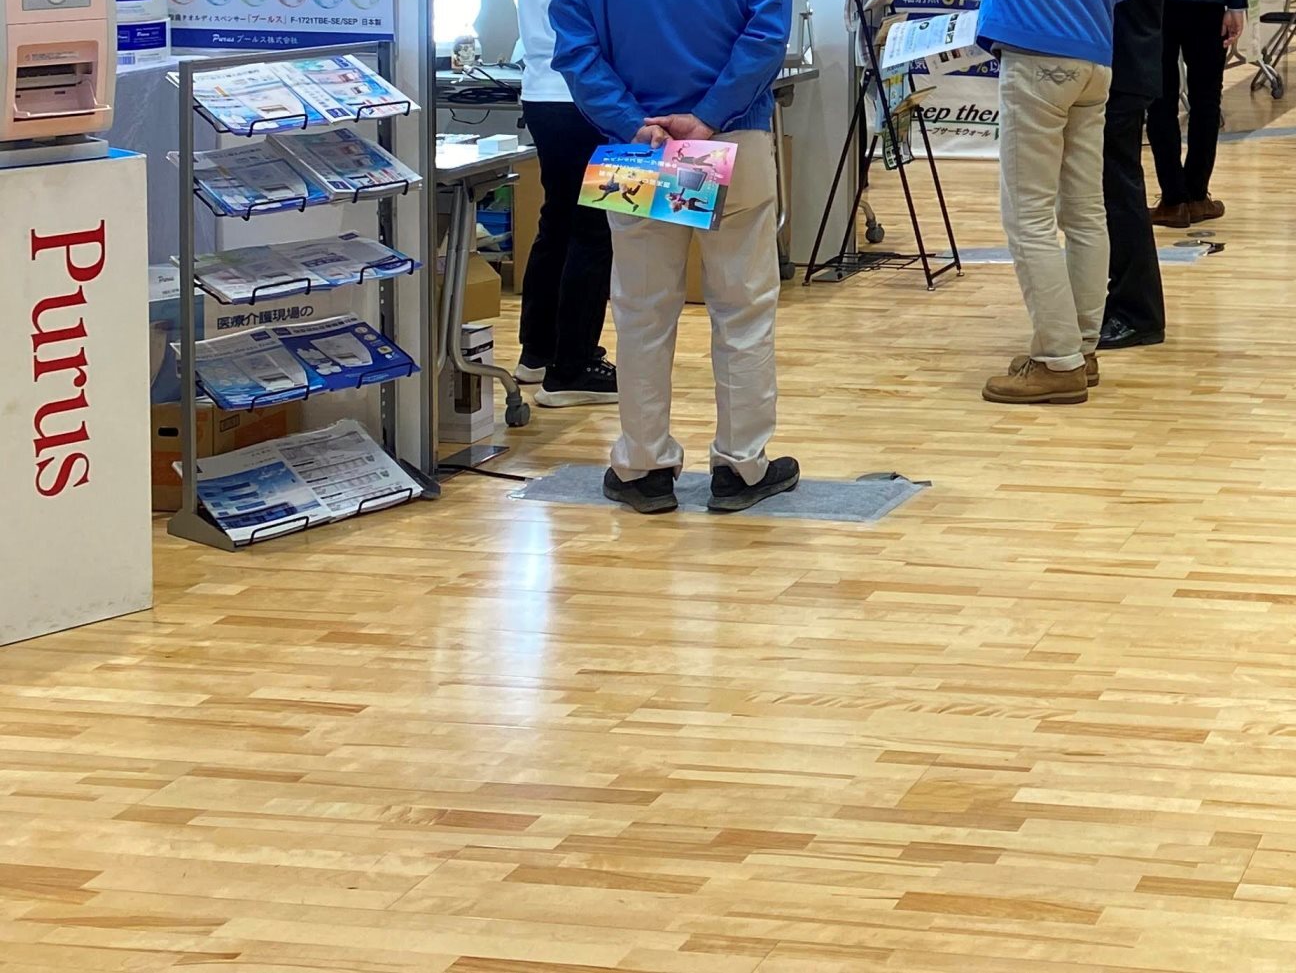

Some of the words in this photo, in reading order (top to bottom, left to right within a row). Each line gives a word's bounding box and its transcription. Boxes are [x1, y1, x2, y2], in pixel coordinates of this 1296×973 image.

[361, 18, 382, 26] 日本製
[925, 127, 992, 137] ープサーモウォール
[216, 304, 314, 331] 医療介護現場の
[31, 219, 106, 497] Purus
